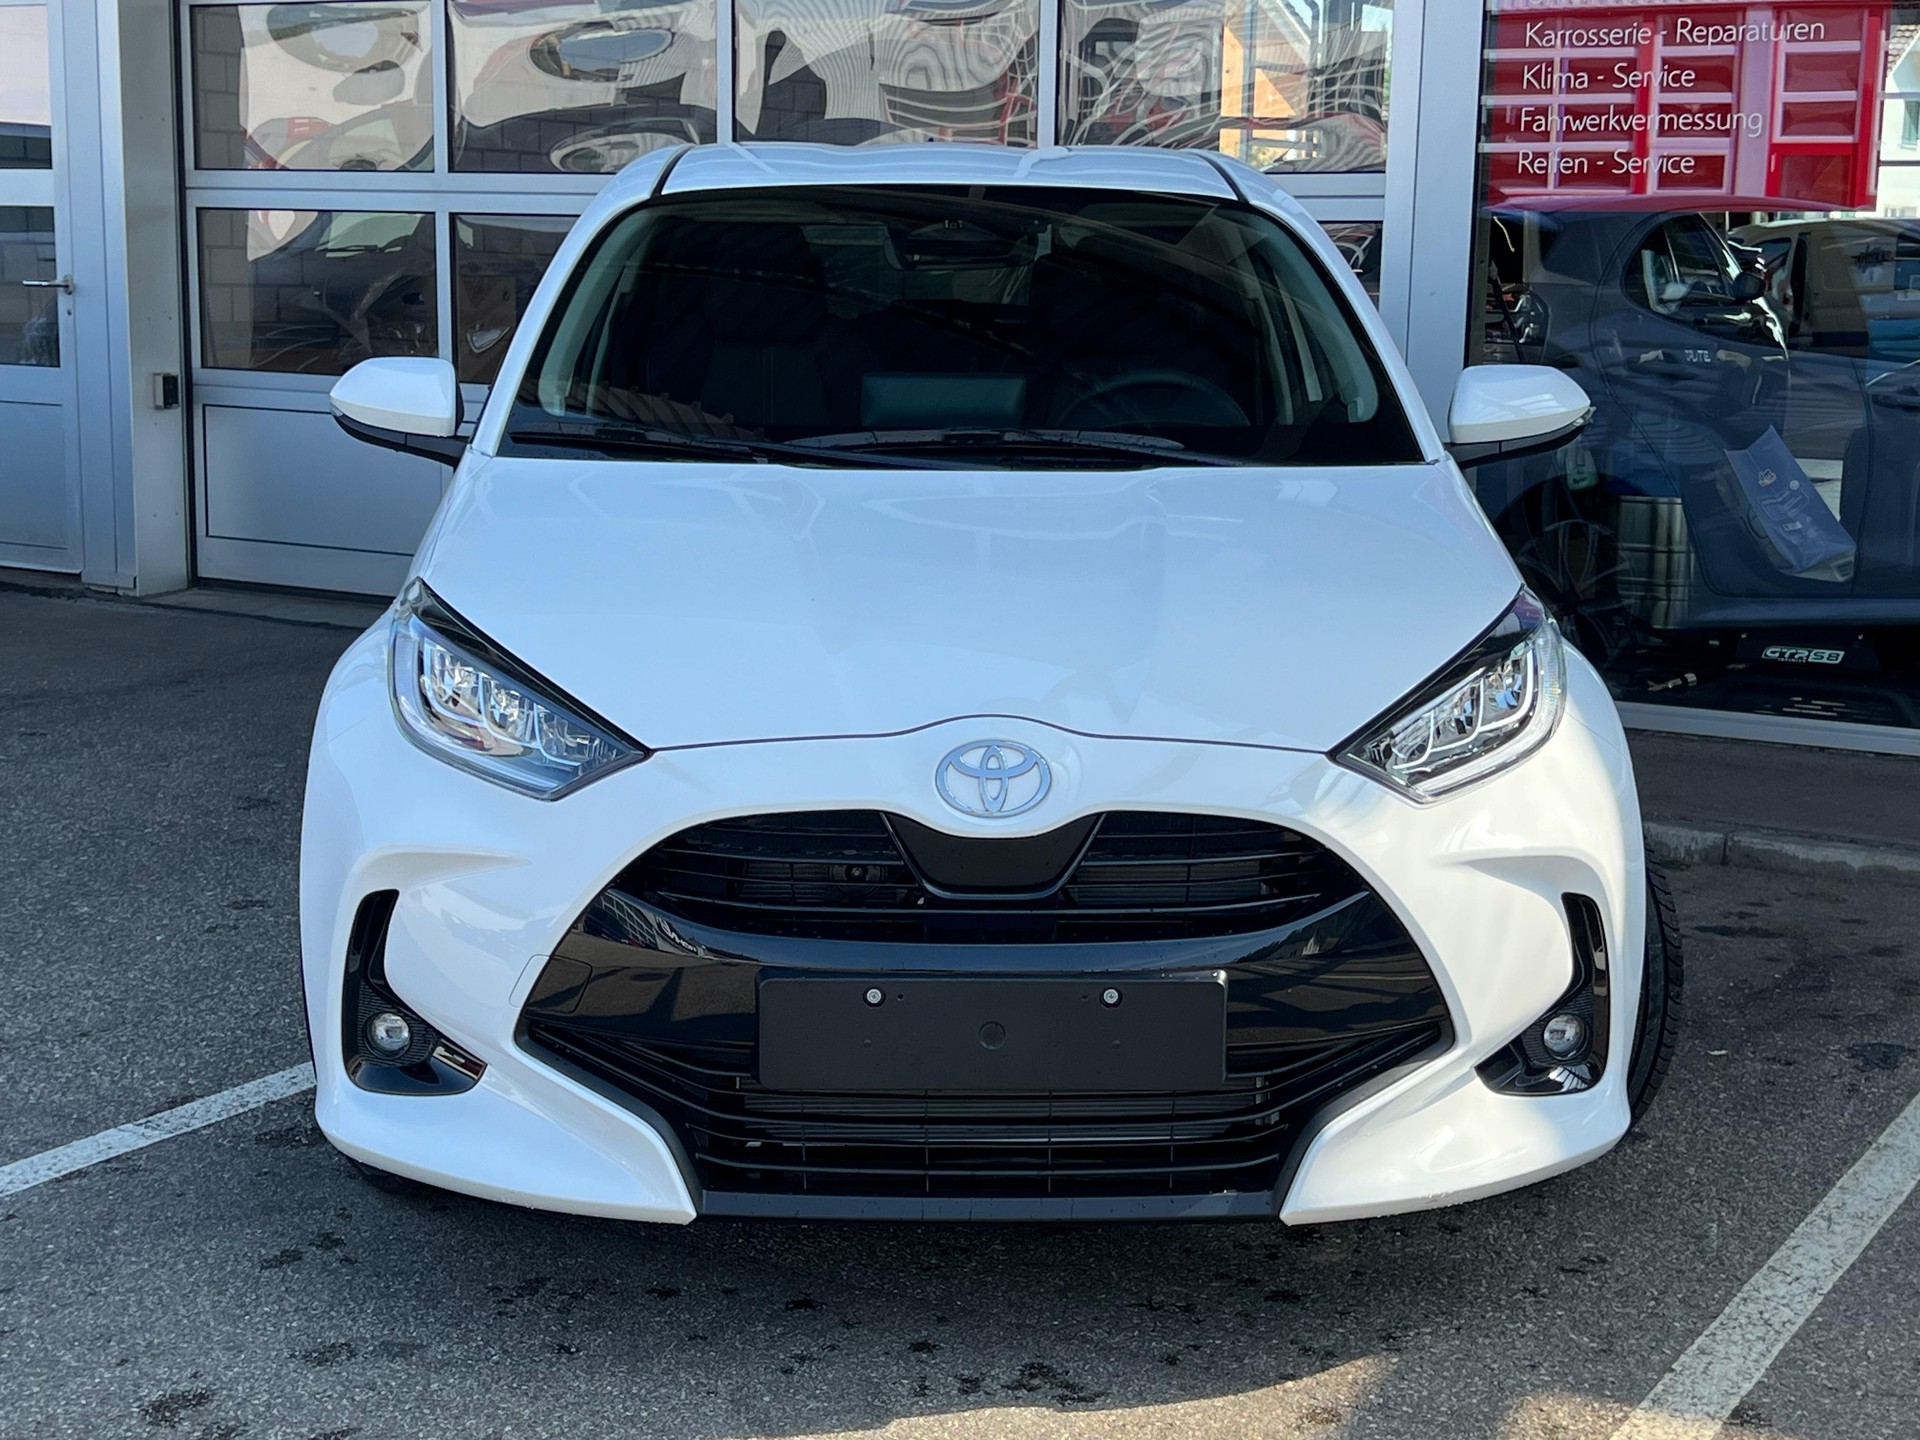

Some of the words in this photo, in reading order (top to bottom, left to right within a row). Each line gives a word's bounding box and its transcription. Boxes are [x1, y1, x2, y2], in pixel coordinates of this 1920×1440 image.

[1525, 22, 1652, 47] Karrosserie
[1676, 17, 1825, 49] Reparaturen
[1522, 62, 1589, 90] Klima
[1612, 62, 1696, 88] Service
[1520, 104, 1763, 138] Fahrwerkvermessung
[1517, 147, 1588, 174] Reifen
[1611, 148, 1695, 174] Service
